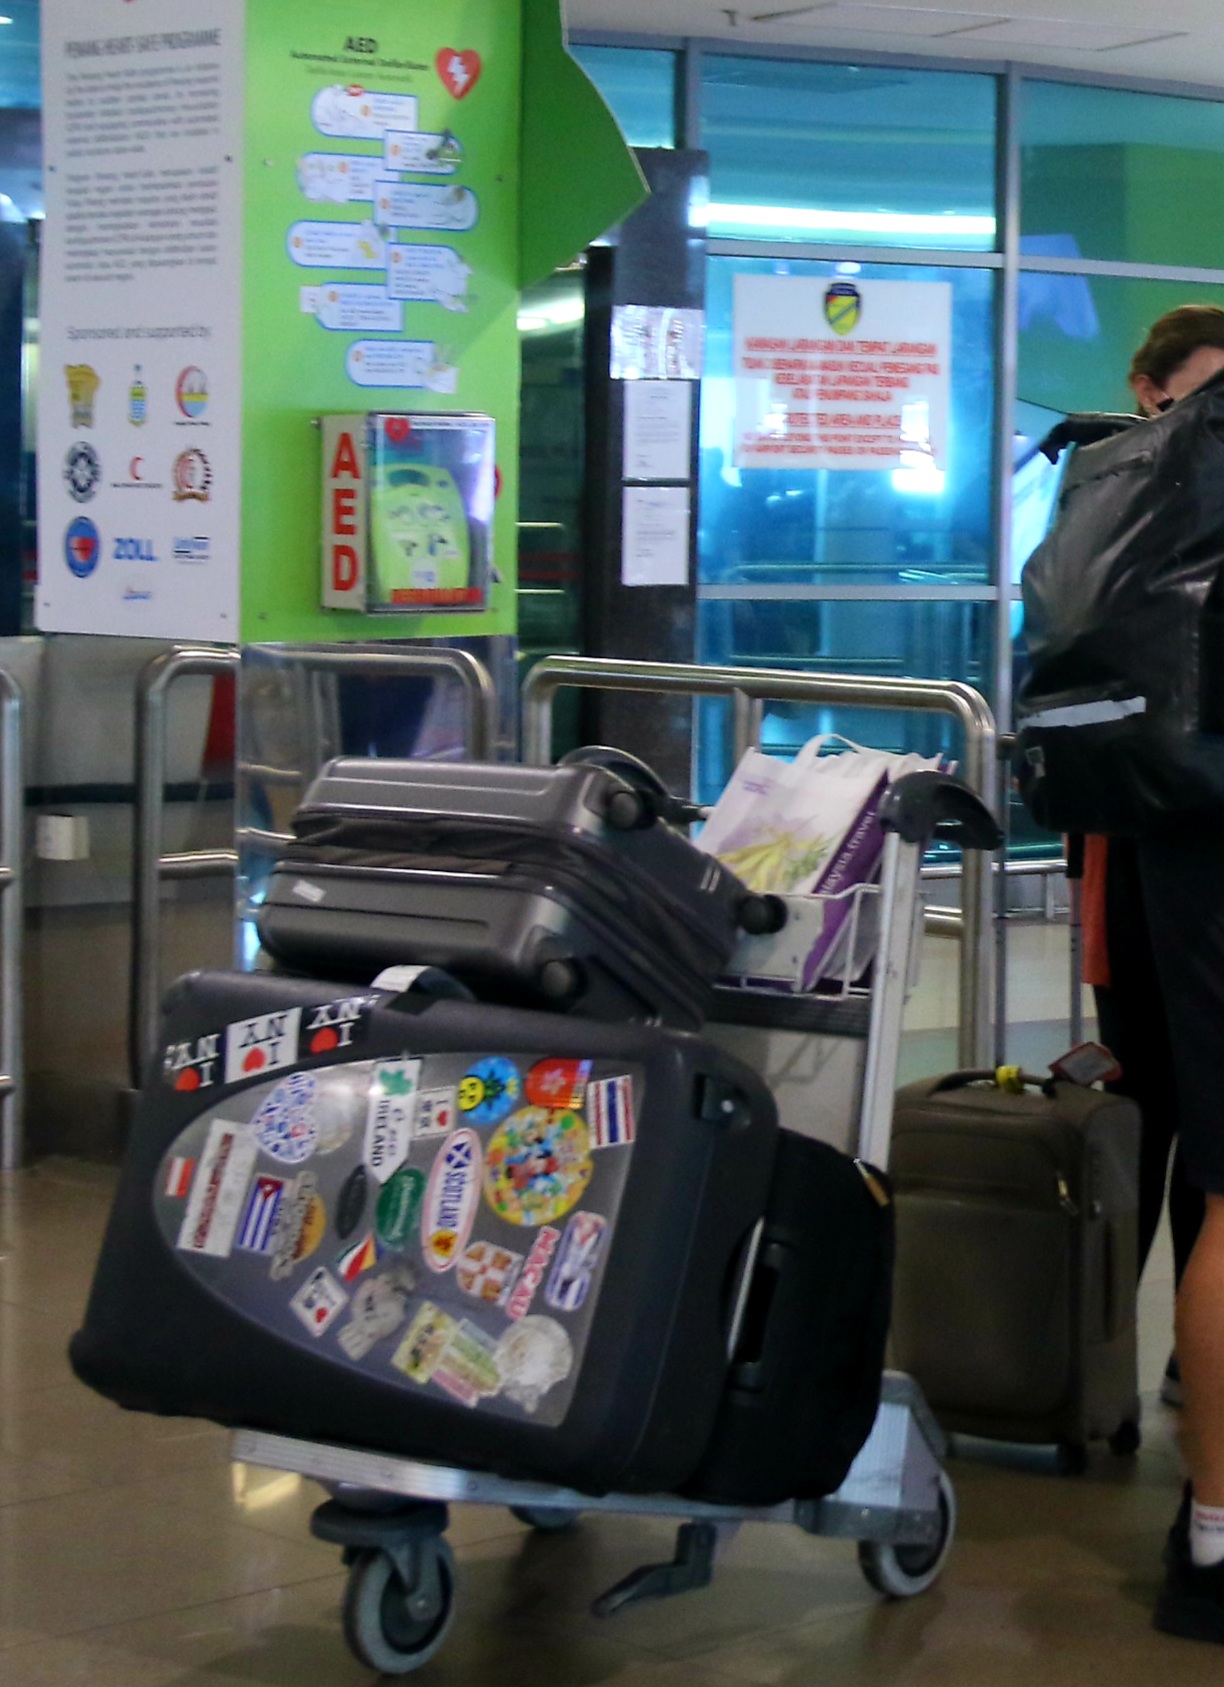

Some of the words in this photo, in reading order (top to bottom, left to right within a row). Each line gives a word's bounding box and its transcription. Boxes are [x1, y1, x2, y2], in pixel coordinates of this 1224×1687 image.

[344, 36, 378, 54] AED
[330, 432, 361, 592] AED
[306, 999, 363, 1029] NY
[239, 1014, 287, 1048] NY
[338, 1021, 355, 1046] I
[269, 1041, 280, 1065] I
[199, 1061, 214, 1087] I
[372, 1099, 391, 1168] IRELAND
[436, 1171, 467, 1229] SCOTLAND
[507, 1227, 560, 1319] MACAU
